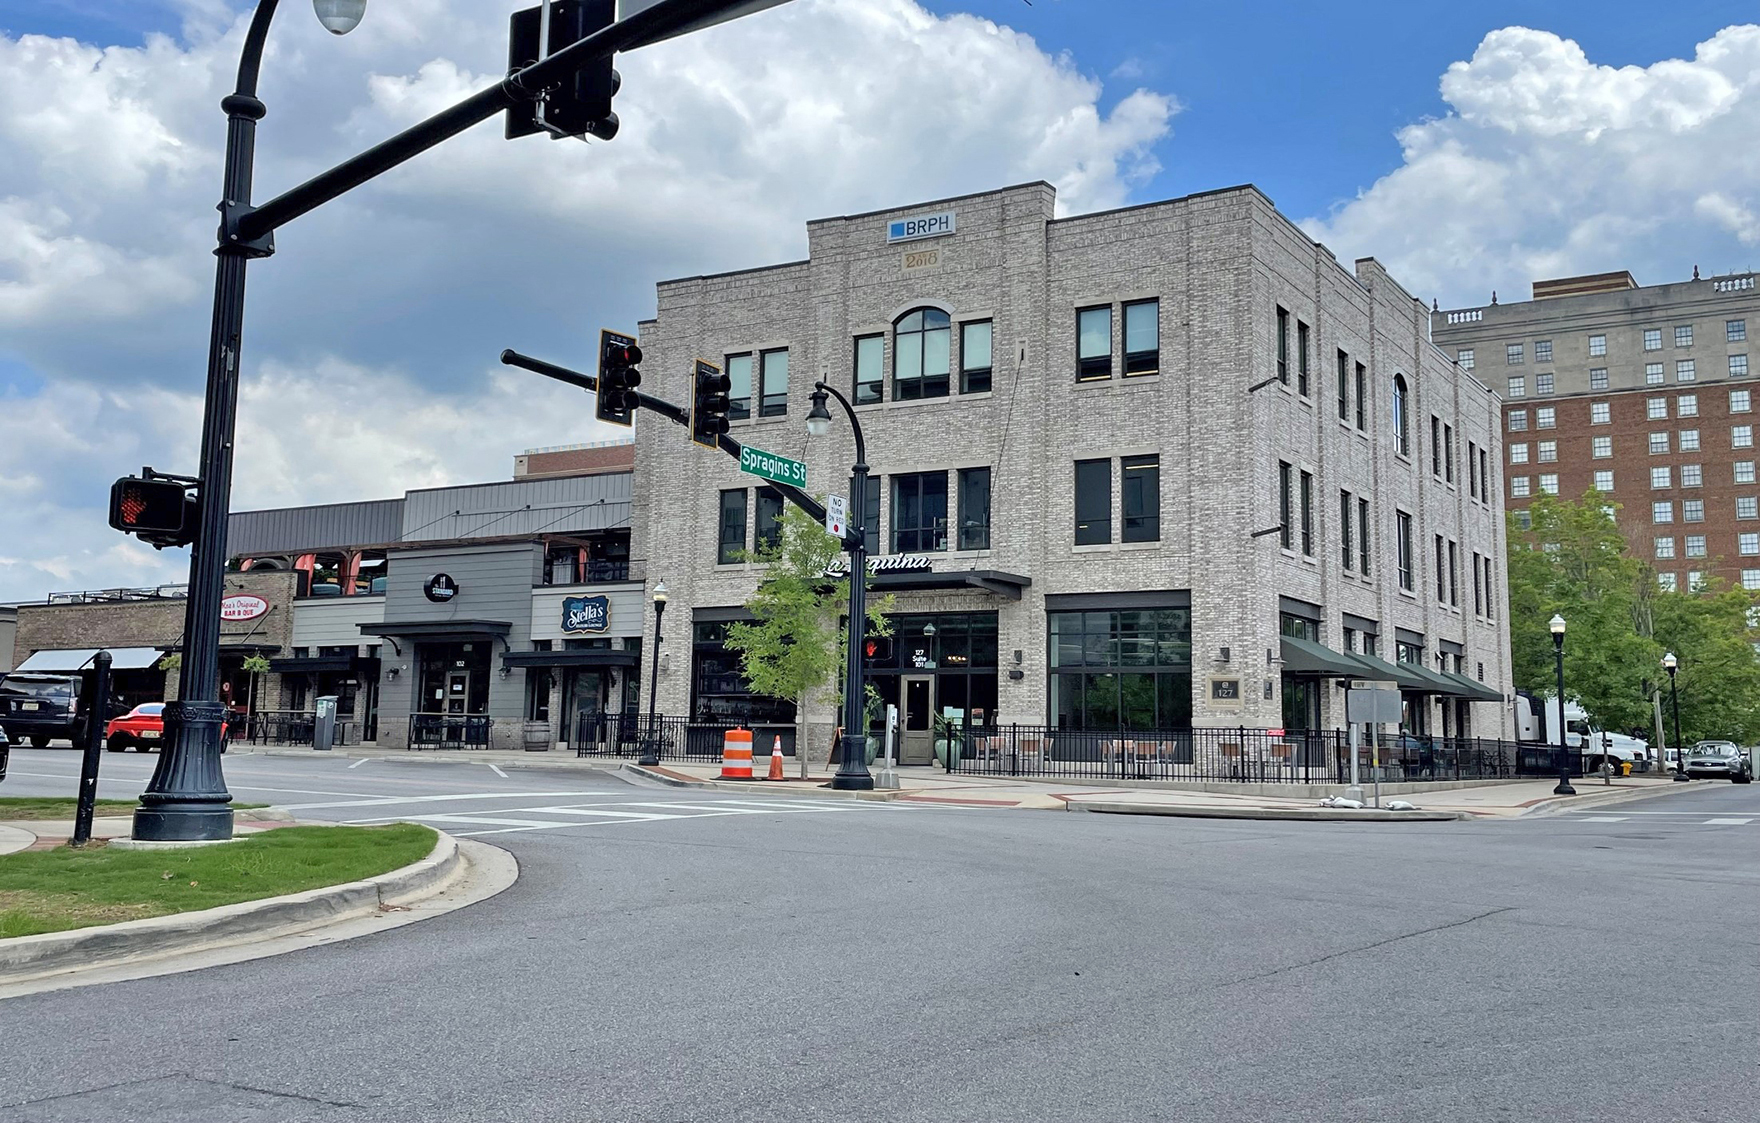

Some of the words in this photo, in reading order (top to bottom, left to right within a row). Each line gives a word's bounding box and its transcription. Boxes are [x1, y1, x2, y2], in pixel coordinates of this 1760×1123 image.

[906, 215, 949, 236] BRPH
[906, 252, 938, 268] 2018
[742, 447, 790, 478] Spragins
[792, 463, 806, 482] St
[833, 498, 842, 507] NO
[831, 507, 843, 515] TURN
[836, 516, 844, 525] RED
[236, 600, 259, 609] Original
[567, 603, 604, 628] Stella's
[1218, 689, 1233, 697] 127
